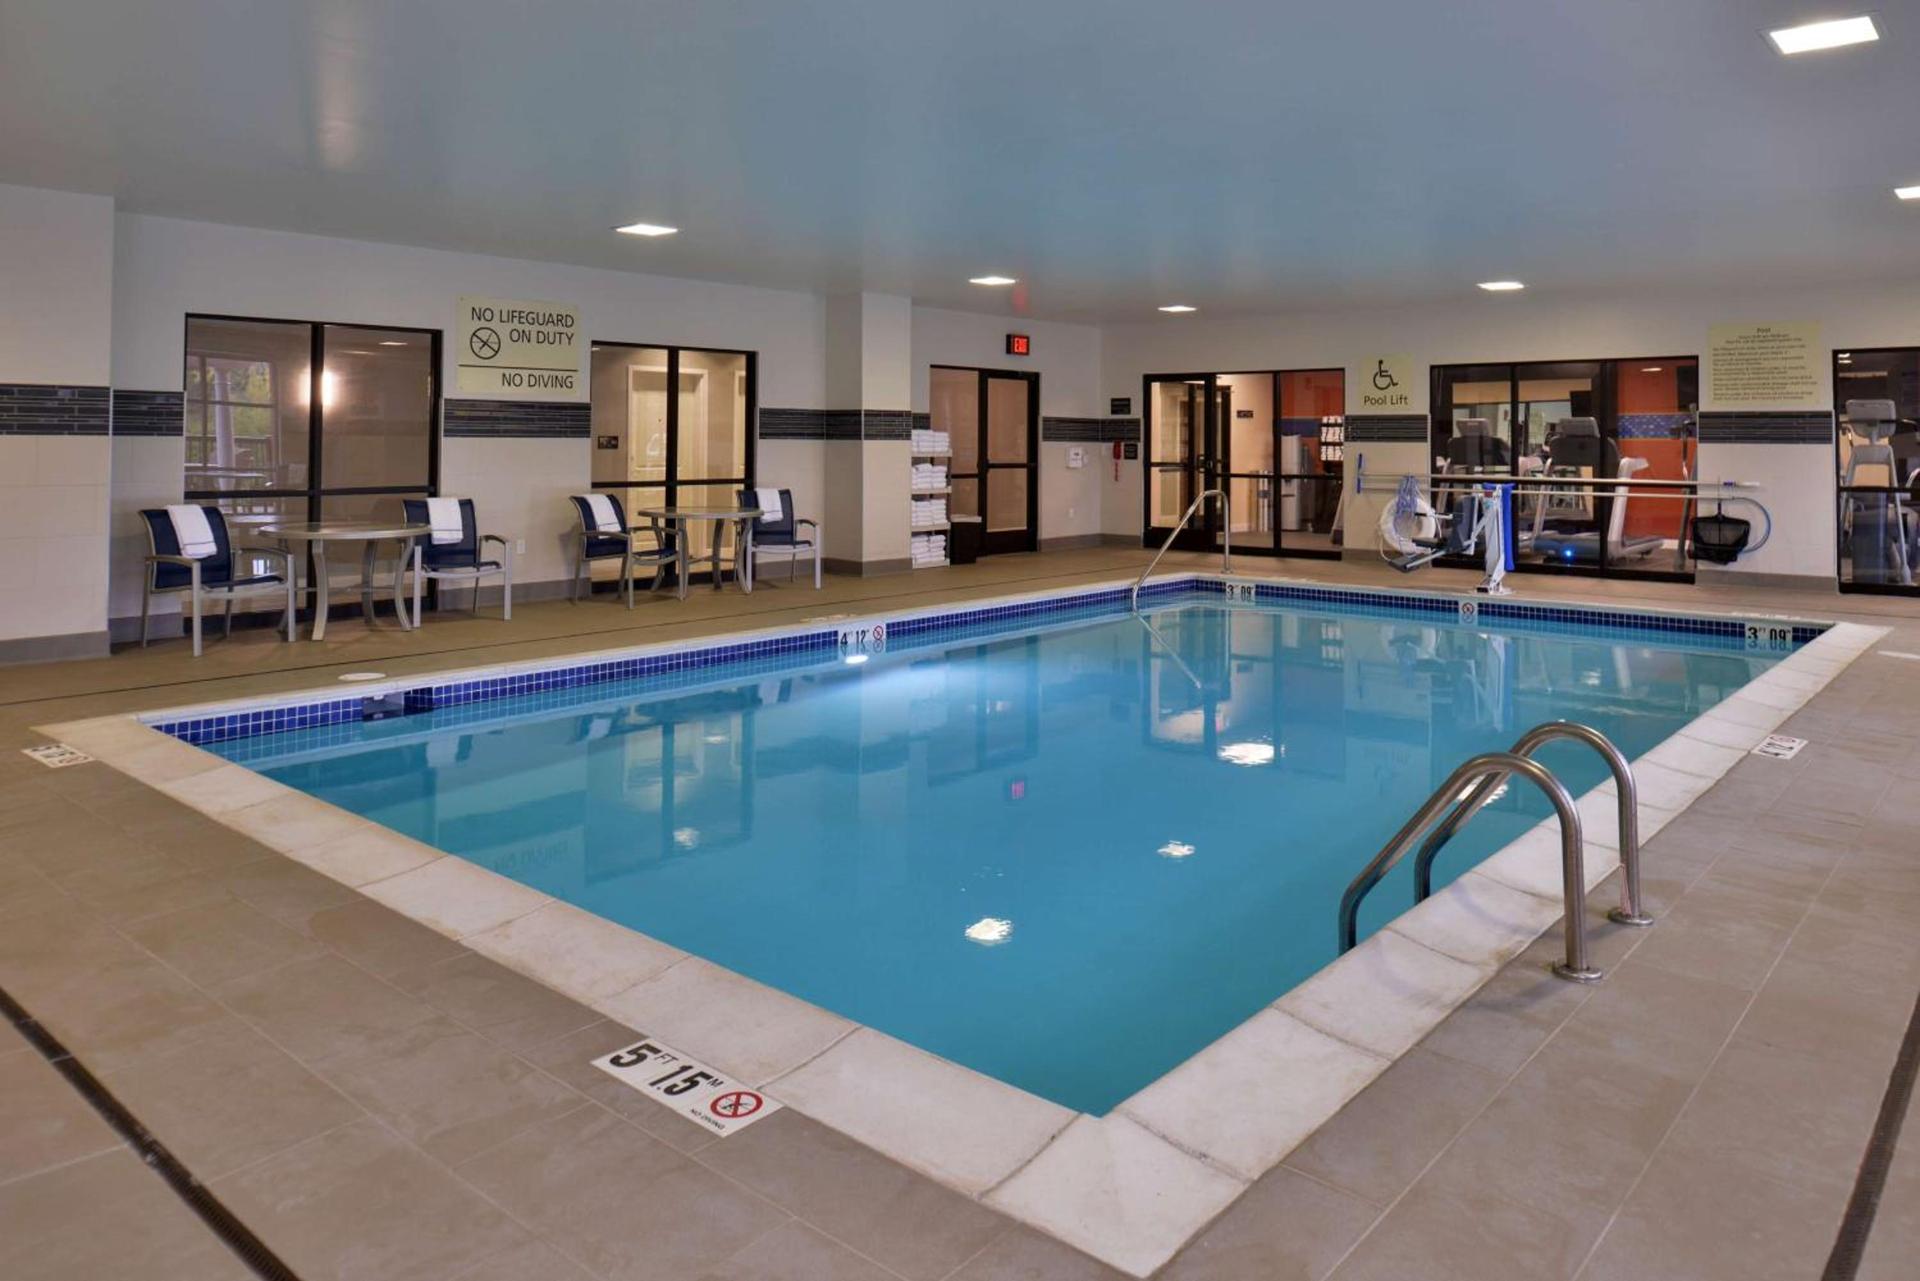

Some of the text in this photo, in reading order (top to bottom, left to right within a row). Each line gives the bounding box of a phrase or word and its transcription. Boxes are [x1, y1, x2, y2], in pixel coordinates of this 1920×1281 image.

[471, 306, 575, 328] NO LIFEGUARD
[509, 328, 575, 346] ON DUTY
[502, 372, 574, 389] NO DIVING
[1364, 394, 1409, 405] Pool Lift
[840, 632, 848, 645] 4
[609, 1043, 662, 1068] 5
[654, 1052, 679, 1065] FT
